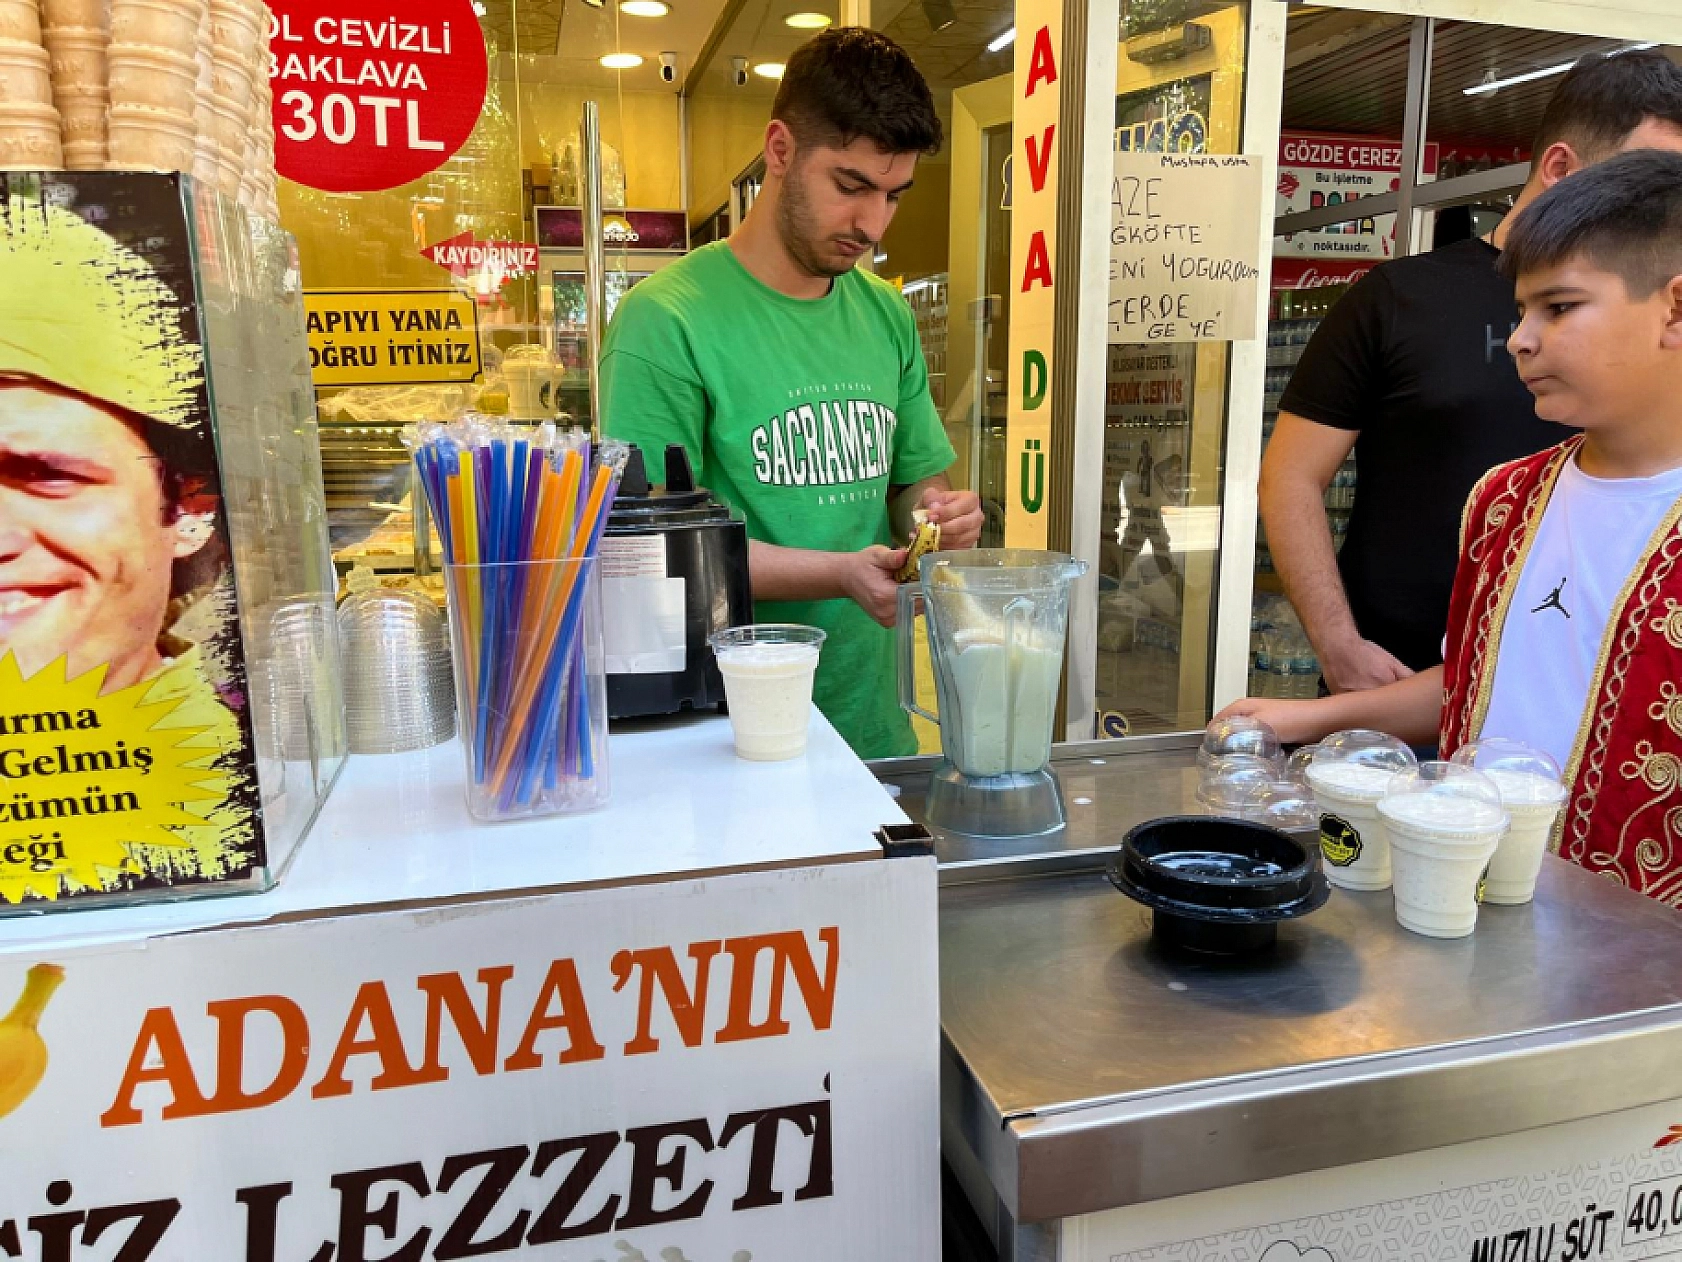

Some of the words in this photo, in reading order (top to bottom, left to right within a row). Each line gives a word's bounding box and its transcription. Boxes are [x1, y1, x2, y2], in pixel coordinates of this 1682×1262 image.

[314, 16, 451, 54] CEVİZLİ
[281, 90, 446, 151] 30TL
[1284, 139, 1345, 164] GÖZDE
[1348, 146, 1402, 168] ÇEREZ
[1315, 172, 1331, 183] Bu
[432, 246, 537, 266] KAYDIRINIZ
[388, 308, 463, 332] YANA
[387, 338, 472, 366] İTİNİZ
[0, 740, 154, 779] Gelmiş
[0, 831, 68, 873] eği
[100, 926, 840, 1128] ADANA'NIN
[1561, 1203, 1615, 1262] SÜT
